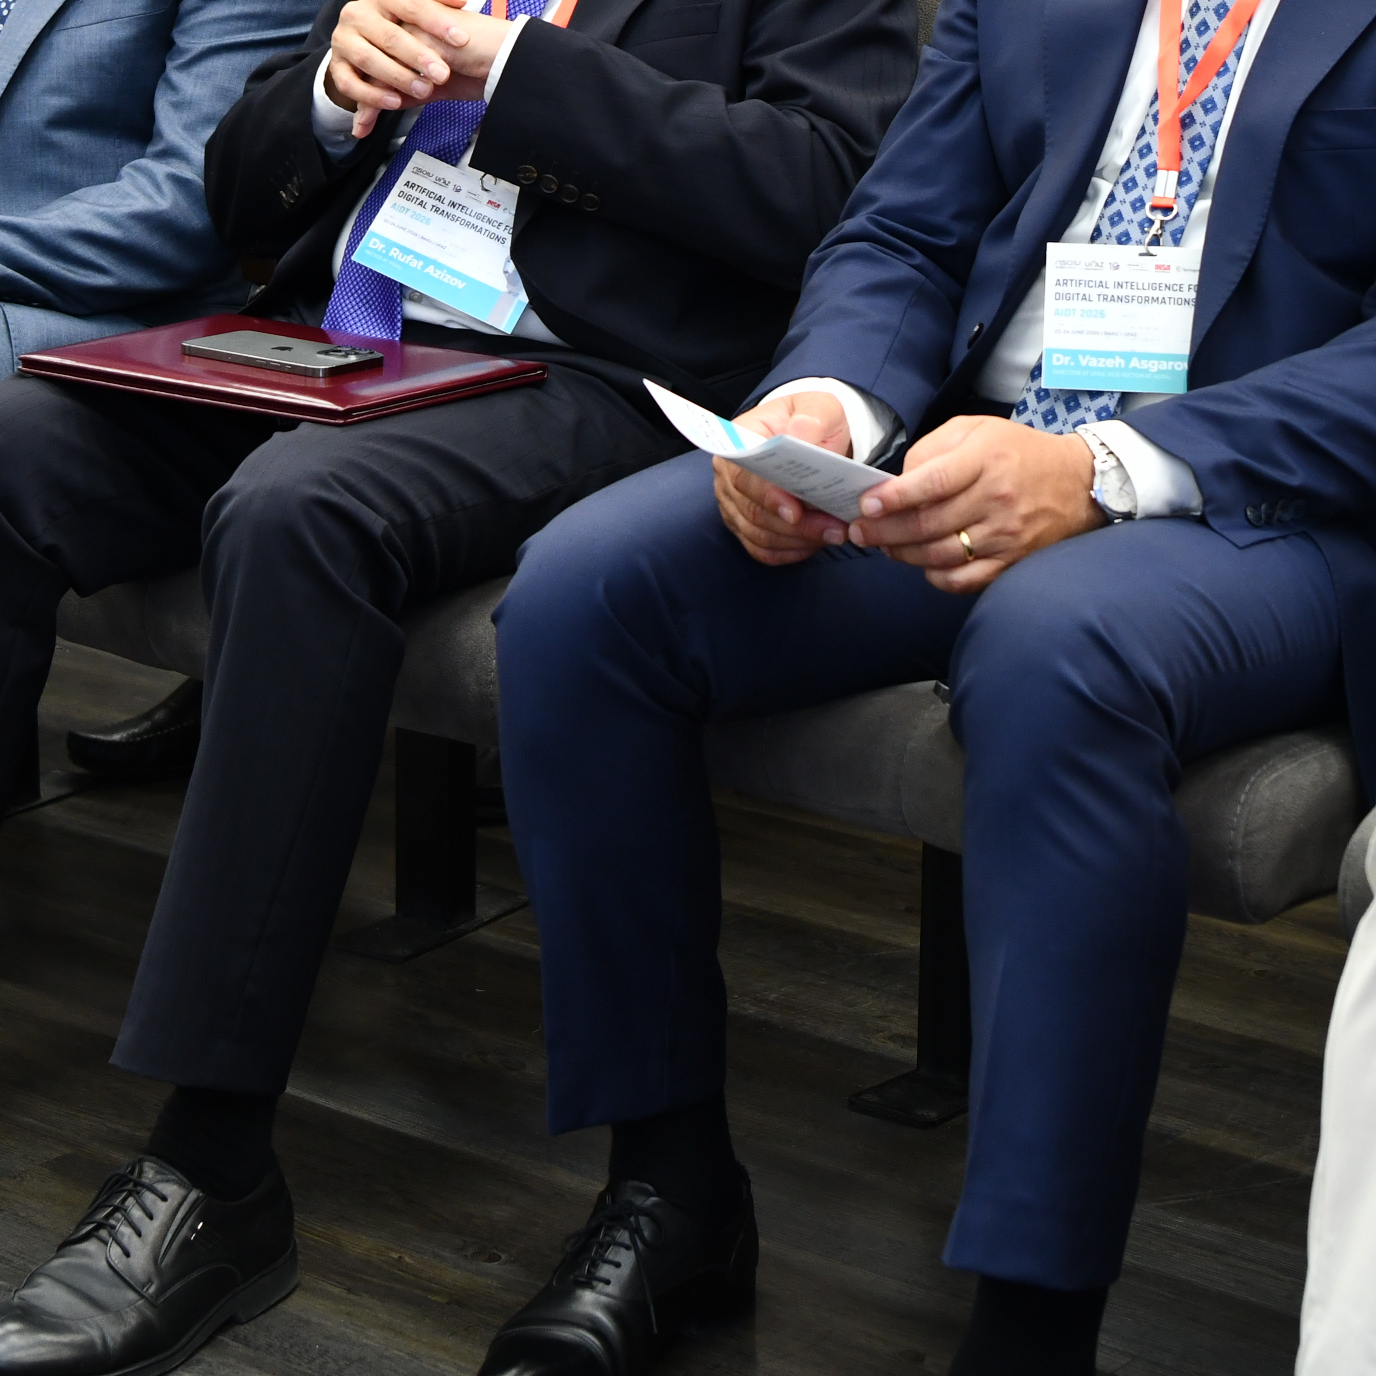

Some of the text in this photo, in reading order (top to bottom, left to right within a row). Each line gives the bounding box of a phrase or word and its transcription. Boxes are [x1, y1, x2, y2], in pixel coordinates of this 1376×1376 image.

[390, 202, 432, 226] AIDT 2026
[403, 180, 445, 205] ARTIFICIAL
[447, 200, 504, 230] INTELLIGENCE
[398, 190, 507, 245] DIGITAL TRANSFORMATIONS
[368, 237, 467, 290] Dr. Rufat Azizov
[1055, 278, 1110, 289] ARTIFICIAL
[1114, 281, 1184, 292] INTELLIGENCE
[1054, 292, 1196, 306] DIGITAL TRANSFORMATIONS
[1054, 308, 1106, 318] AIDT 2026
[1052, 354, 1188, 372] Dr. Vazeh Asgarov
